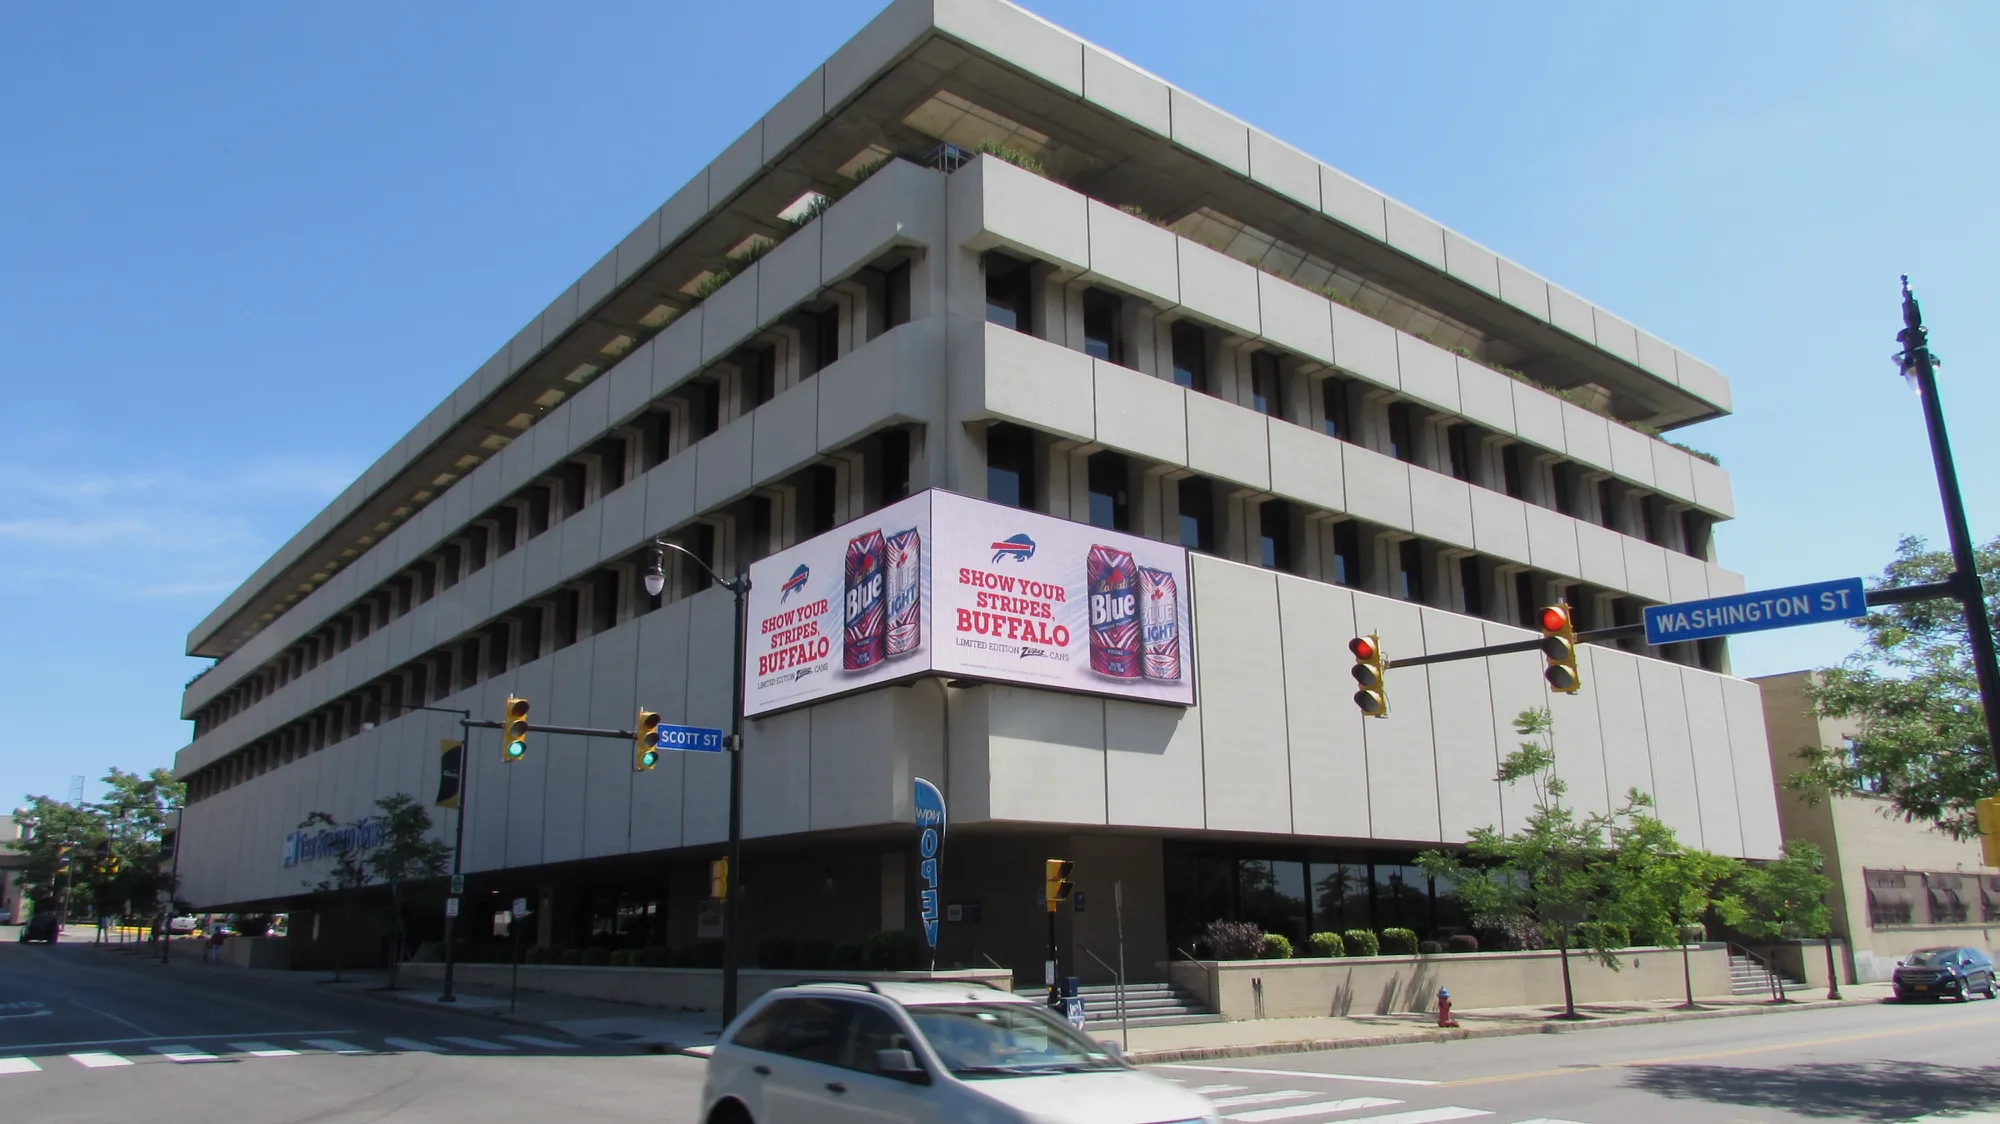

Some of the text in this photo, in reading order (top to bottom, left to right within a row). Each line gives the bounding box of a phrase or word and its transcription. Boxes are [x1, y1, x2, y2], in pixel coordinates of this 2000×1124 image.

[846, 573, 882, 624] Blue
[959, 568, 1066, 602] SHOW YOUR
[761, 610, 795, 634] SHOW
[796, 598, 829, 622] YOUR
[977, 591, 1055, 622] STRIPES,
[1091, 593, 1135, 625] Blue
[1656, 589, 1850, 633] WASHINGTON ST
[771, 620, 820, 649] STRIPES,
[956, 608, 1069, 647] BUFFALO
[1144, 622, 1175, 642] LIGHT
[758, 636, 830, 676] BUFFALO
[956, 637, 987, 649] LIMITED
[989, 642, 1020, 654] EDITION
[1049, 651, 1069, 662] CANS
[757, 678, 775, 689] LIMITED
[776, 672, 795, 684] EDITION
[814, 662, 828, 674] CANS
[661, 730, 718, 747] SCOTT ST
